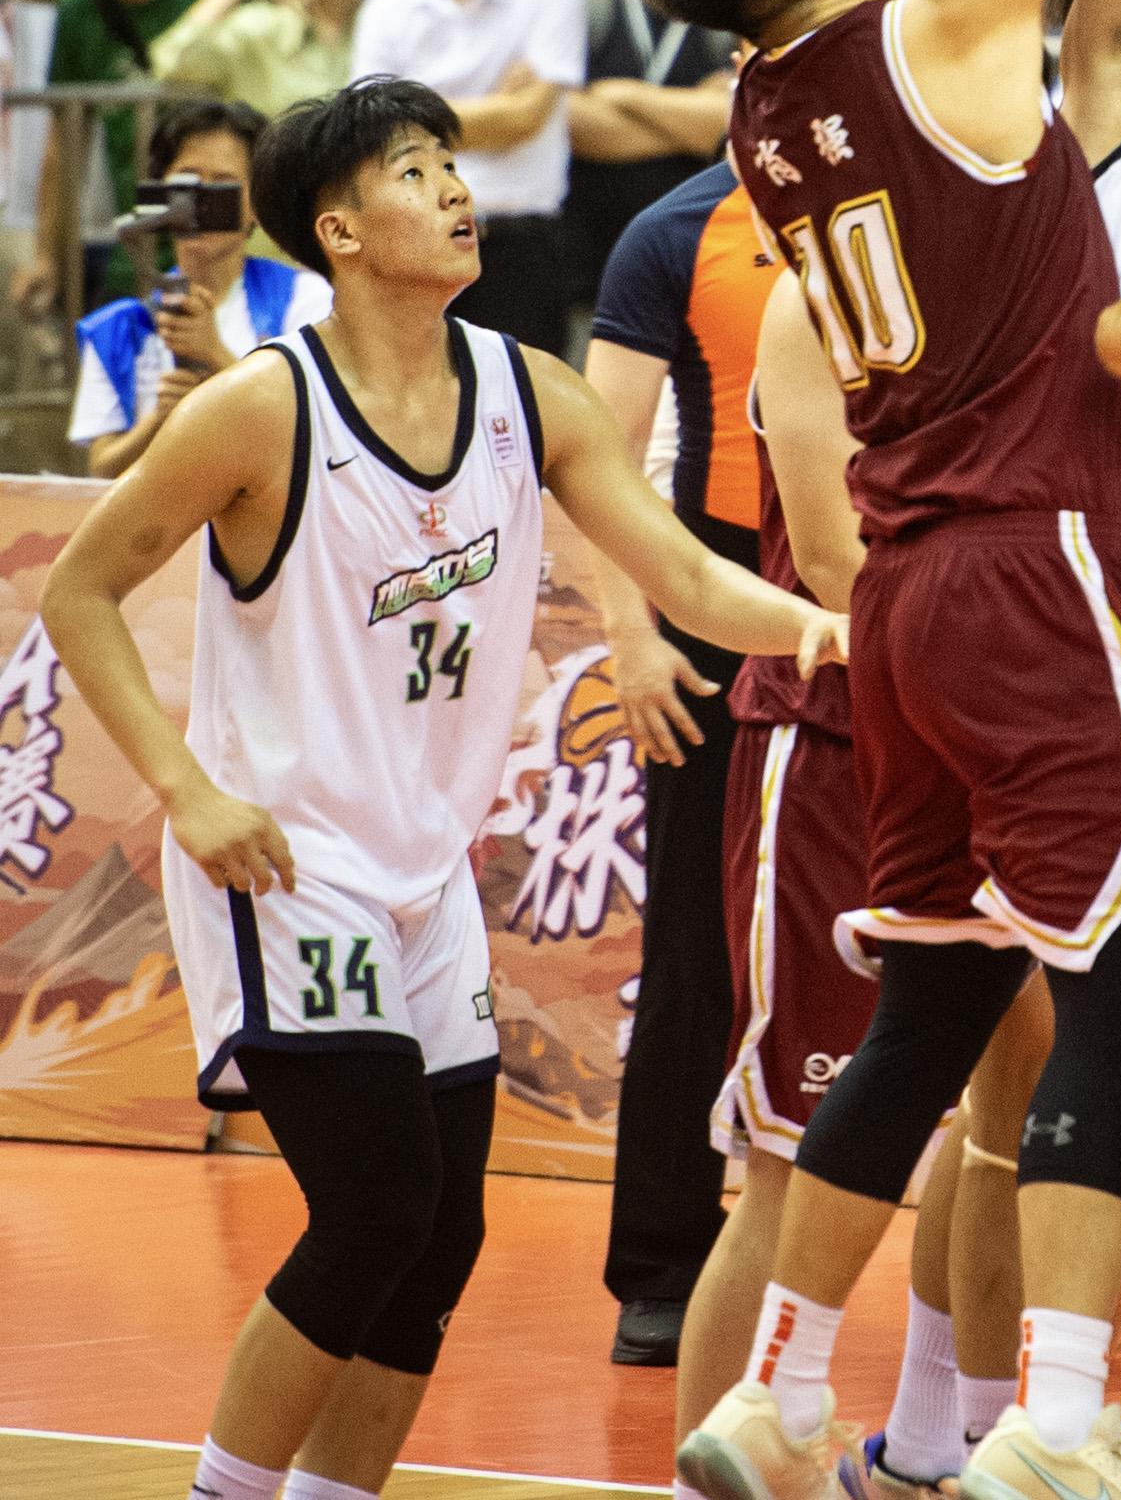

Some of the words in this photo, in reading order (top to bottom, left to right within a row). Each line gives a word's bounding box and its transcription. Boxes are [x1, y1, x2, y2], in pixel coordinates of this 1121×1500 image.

[781, 188, 927, 391] 10
[405, 620, 473, 704] 34
[298, 936, 384, 1020] 34
